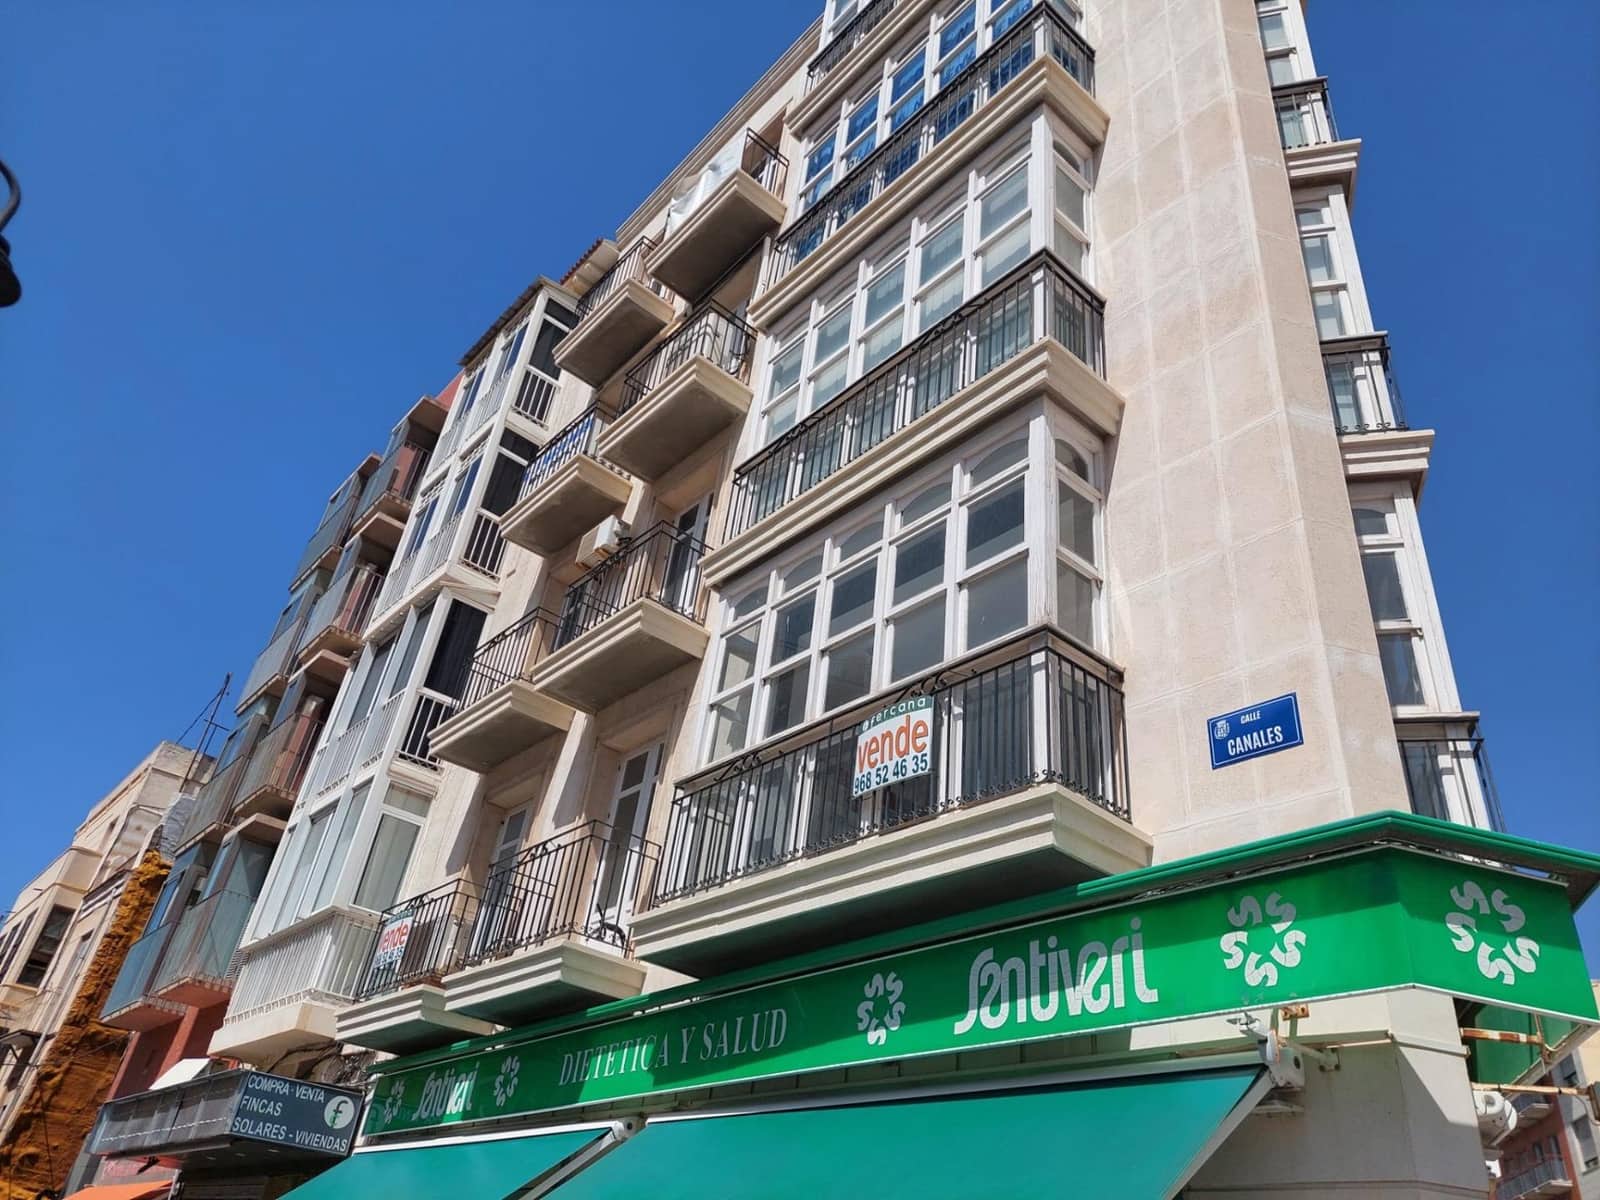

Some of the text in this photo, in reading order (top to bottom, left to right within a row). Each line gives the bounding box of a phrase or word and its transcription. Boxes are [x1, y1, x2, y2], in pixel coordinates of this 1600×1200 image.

[1240, 710, 1261, 724] CALLE
[858, 714, 929, 774] vende
[1227, 725, 1284, 756] CANALES
[854, 752, 928, 794] 968 52 46 35
[558, 1007, 788, 1086] DIETETICA Y SALUD
[239, 1095, 283, 1117] FINCAS
[247, 1075, 290, 1096] COMPRA
[295, 1085, 325, 1104] VENTA
[232, 1117, 287, 1140] SOLARES
[295, 1130, 348, 1152] VIVIENDAS
